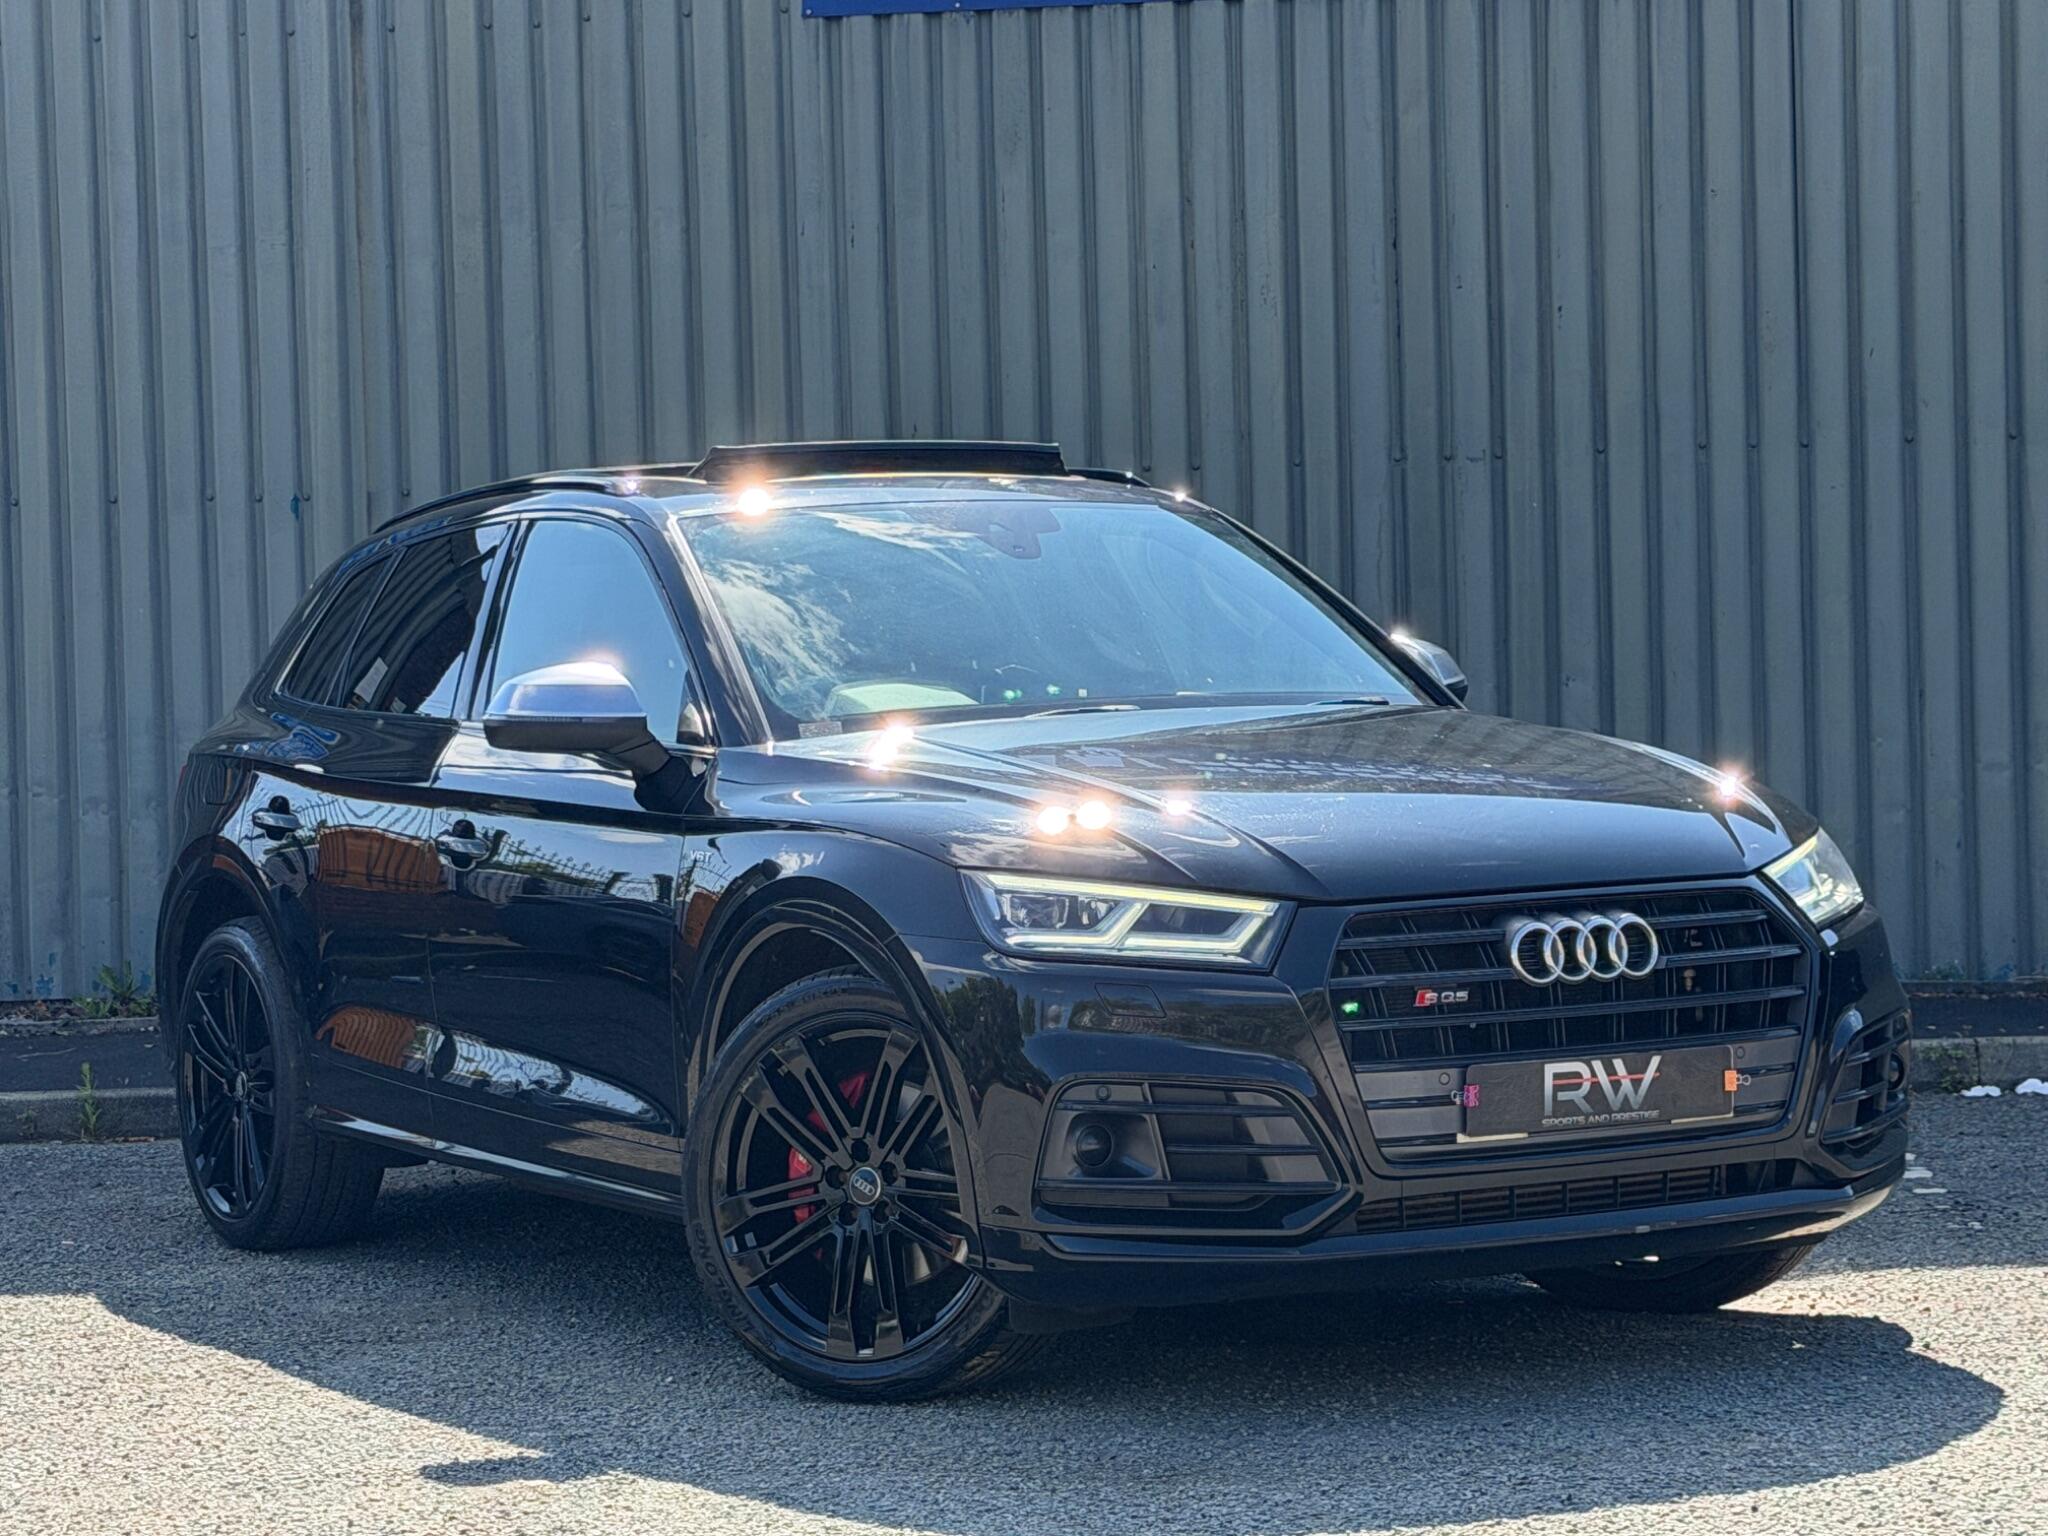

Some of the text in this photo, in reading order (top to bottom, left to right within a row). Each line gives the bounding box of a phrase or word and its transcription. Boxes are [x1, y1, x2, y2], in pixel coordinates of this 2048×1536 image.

[690, 850, 712, 863] V6T
[1417, 989, 1469, 1005] SQ5
[1544, 1055, 1662, 1115] RW
[1541, 1109, 1660, 1127] SPORTS AND PRESTIGE
